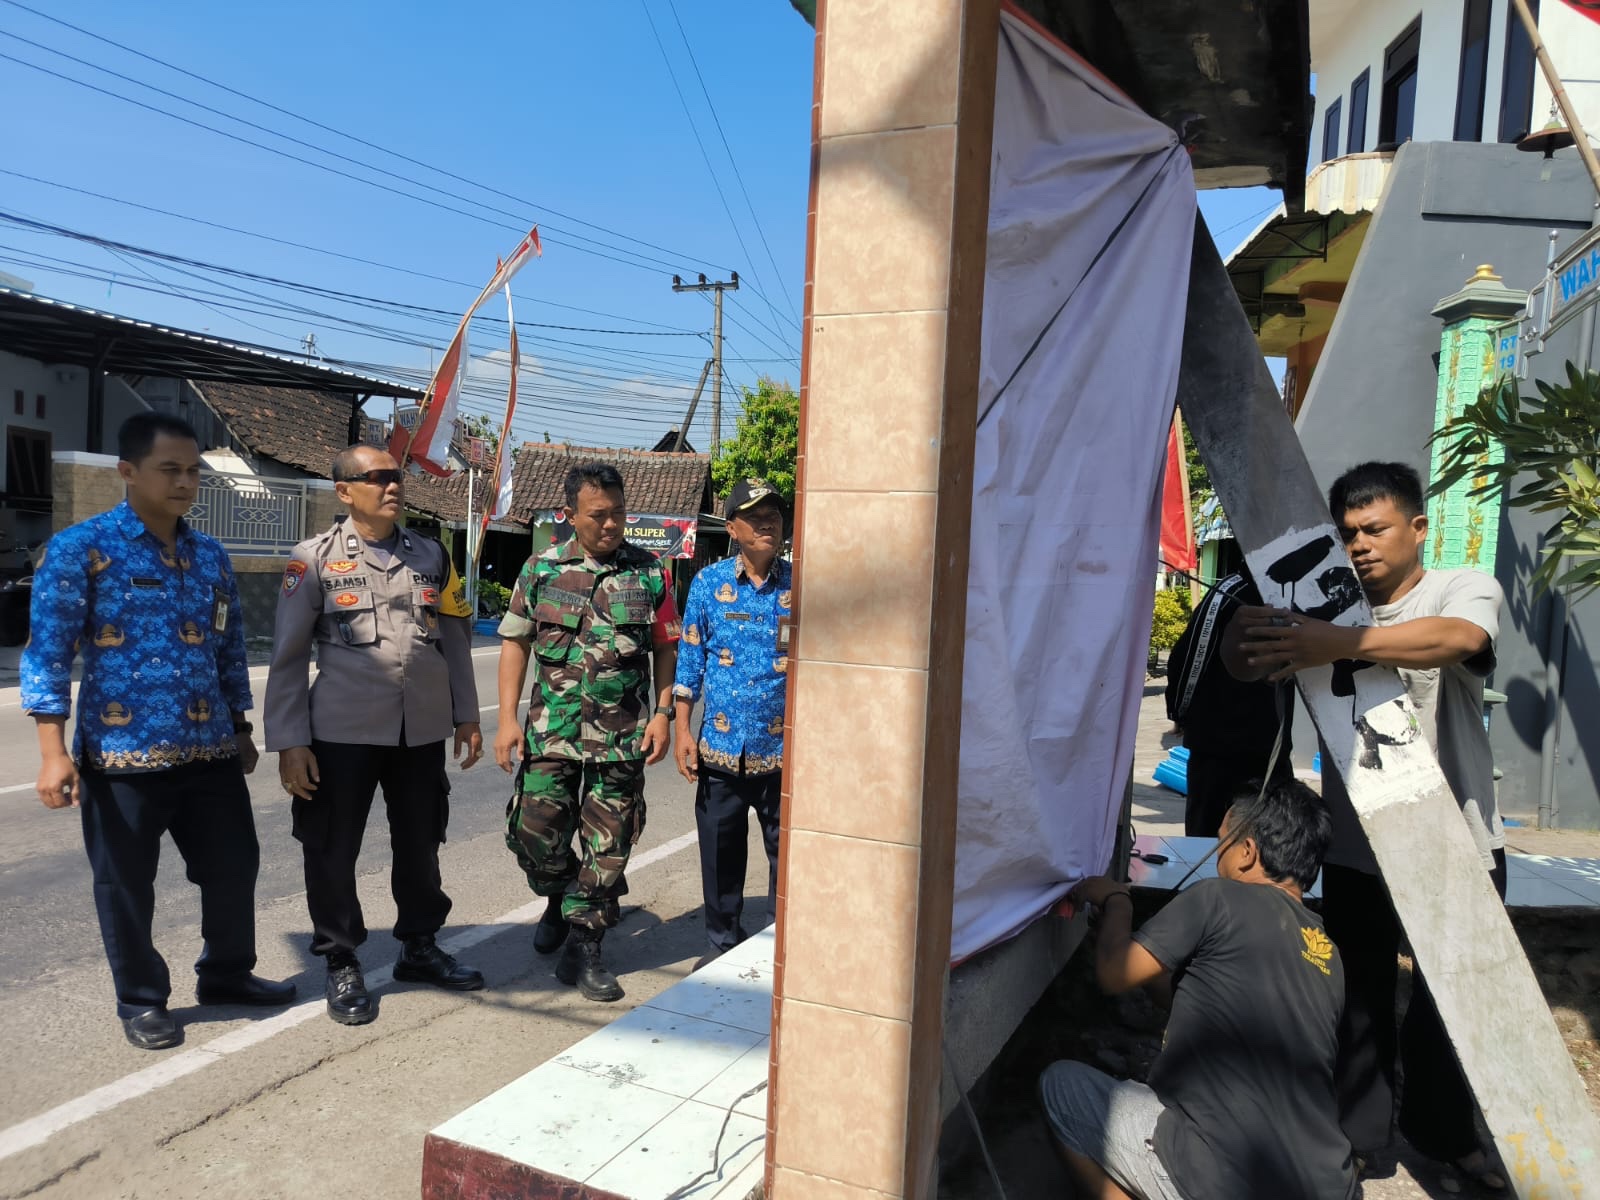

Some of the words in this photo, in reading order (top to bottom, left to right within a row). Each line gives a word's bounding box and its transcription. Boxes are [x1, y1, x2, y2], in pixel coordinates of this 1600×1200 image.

[1500, 335, 1518, 351] RT
[1500, 354, 1516, 369] 19
[633, 527, 666, 538] SUPER
[324, 576, 367, 590] SAMSI
